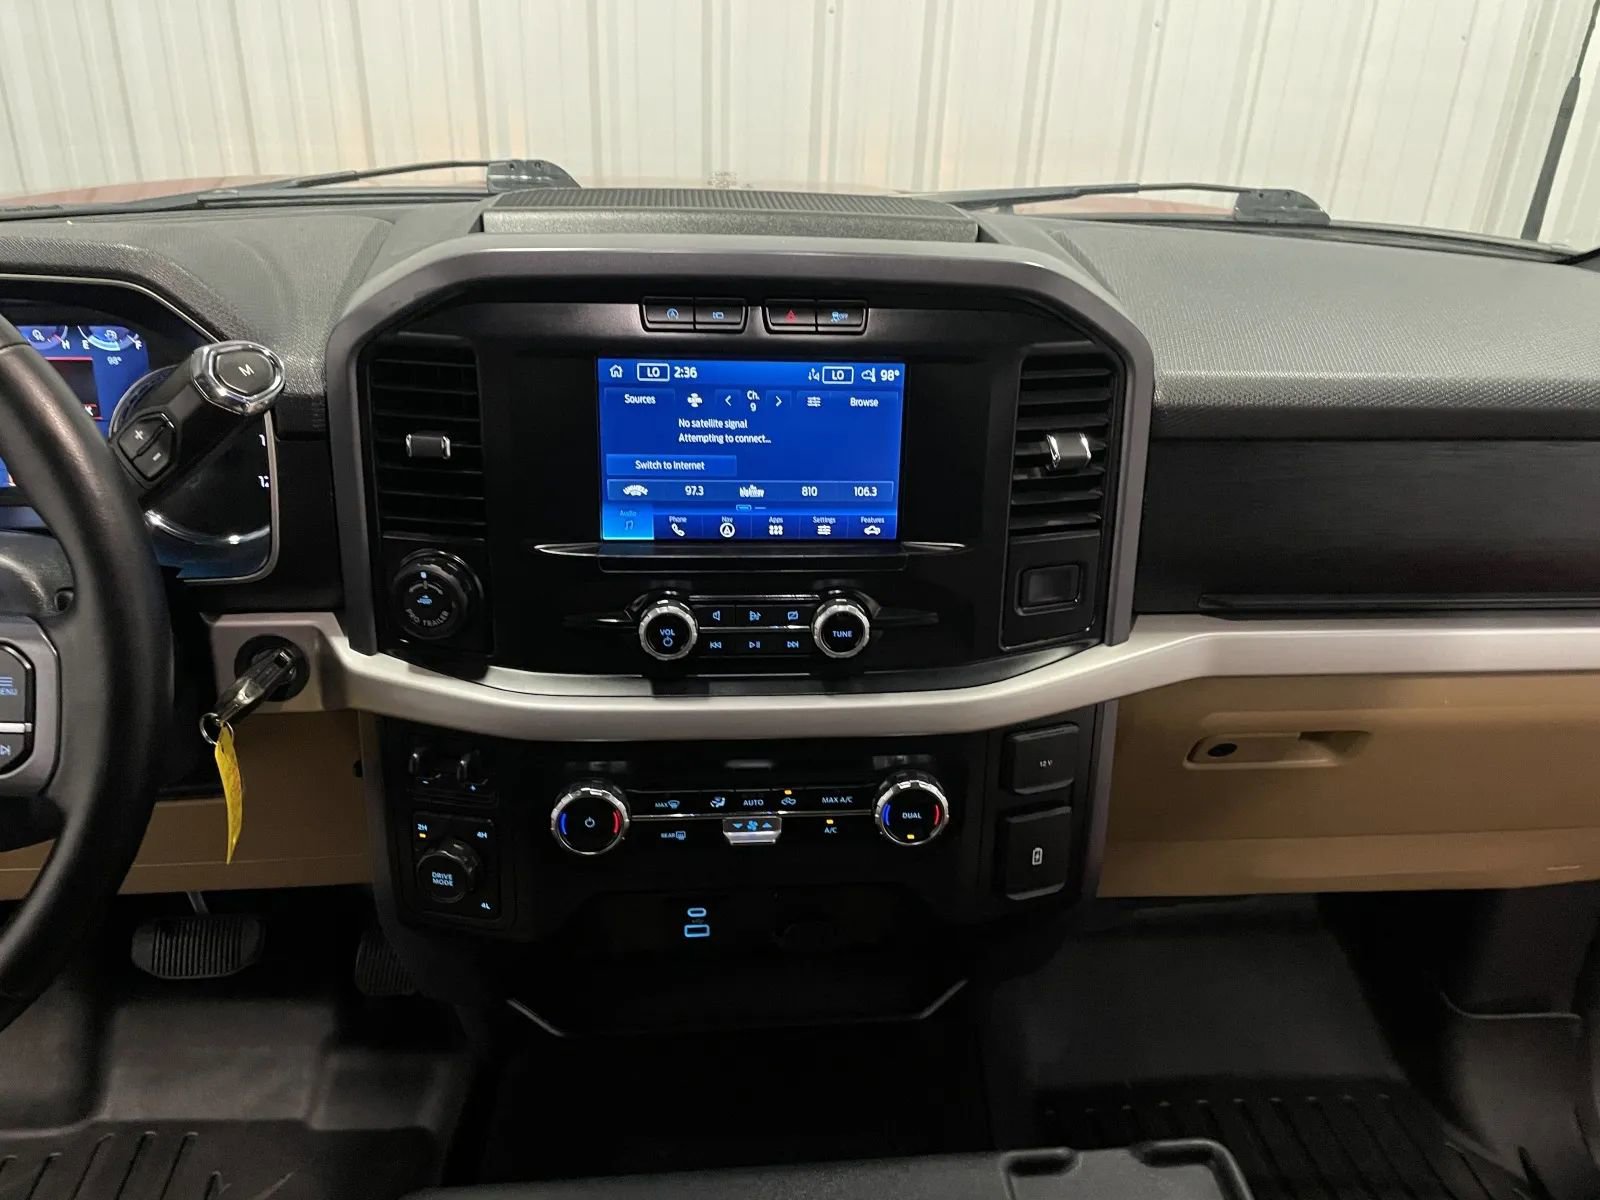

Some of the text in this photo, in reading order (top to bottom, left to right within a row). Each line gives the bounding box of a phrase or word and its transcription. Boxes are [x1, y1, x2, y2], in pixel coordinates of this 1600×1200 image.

[238, 364, 255, 377] M
[646, 366, 661, 378] LO
[673, 366, 698, 379] 2:36
[831, 370, 845, 381] LO
[880, 369, 900, 382] 98°
[624, 393, 657, 405] Sources
[850, 397, 879, 407] Browse
[750, 402, 757, 412] 9
[678, 418, 748, 430] No satellite signal
[678, 433, 724, 445] Attempting
[725, 434, 734, 444] to
[635, 460, 705, 471] Switch to Internet
[684, 485, 704, 497] 97.3
[801, 486, 818, 497] 810
[854, 486, 878, 497] 106.3
[768, 516, 784, 524] Apps
[812, 516, 836, 525] Settings
[860, 516, 885, 524] Features
[659, 628, 676, 637] VOL
[832, 630, 853, 639] TUNE
[743, 799, 764, 807] AUTO
[821, 796, 853, 804] MAX A/C
[902, 812, 922, 820] DUAL
[824, 826, 838, 835] A/C
[432, 872, 453, 880] DRIVE
[432, 878, 453, 886] MODE
